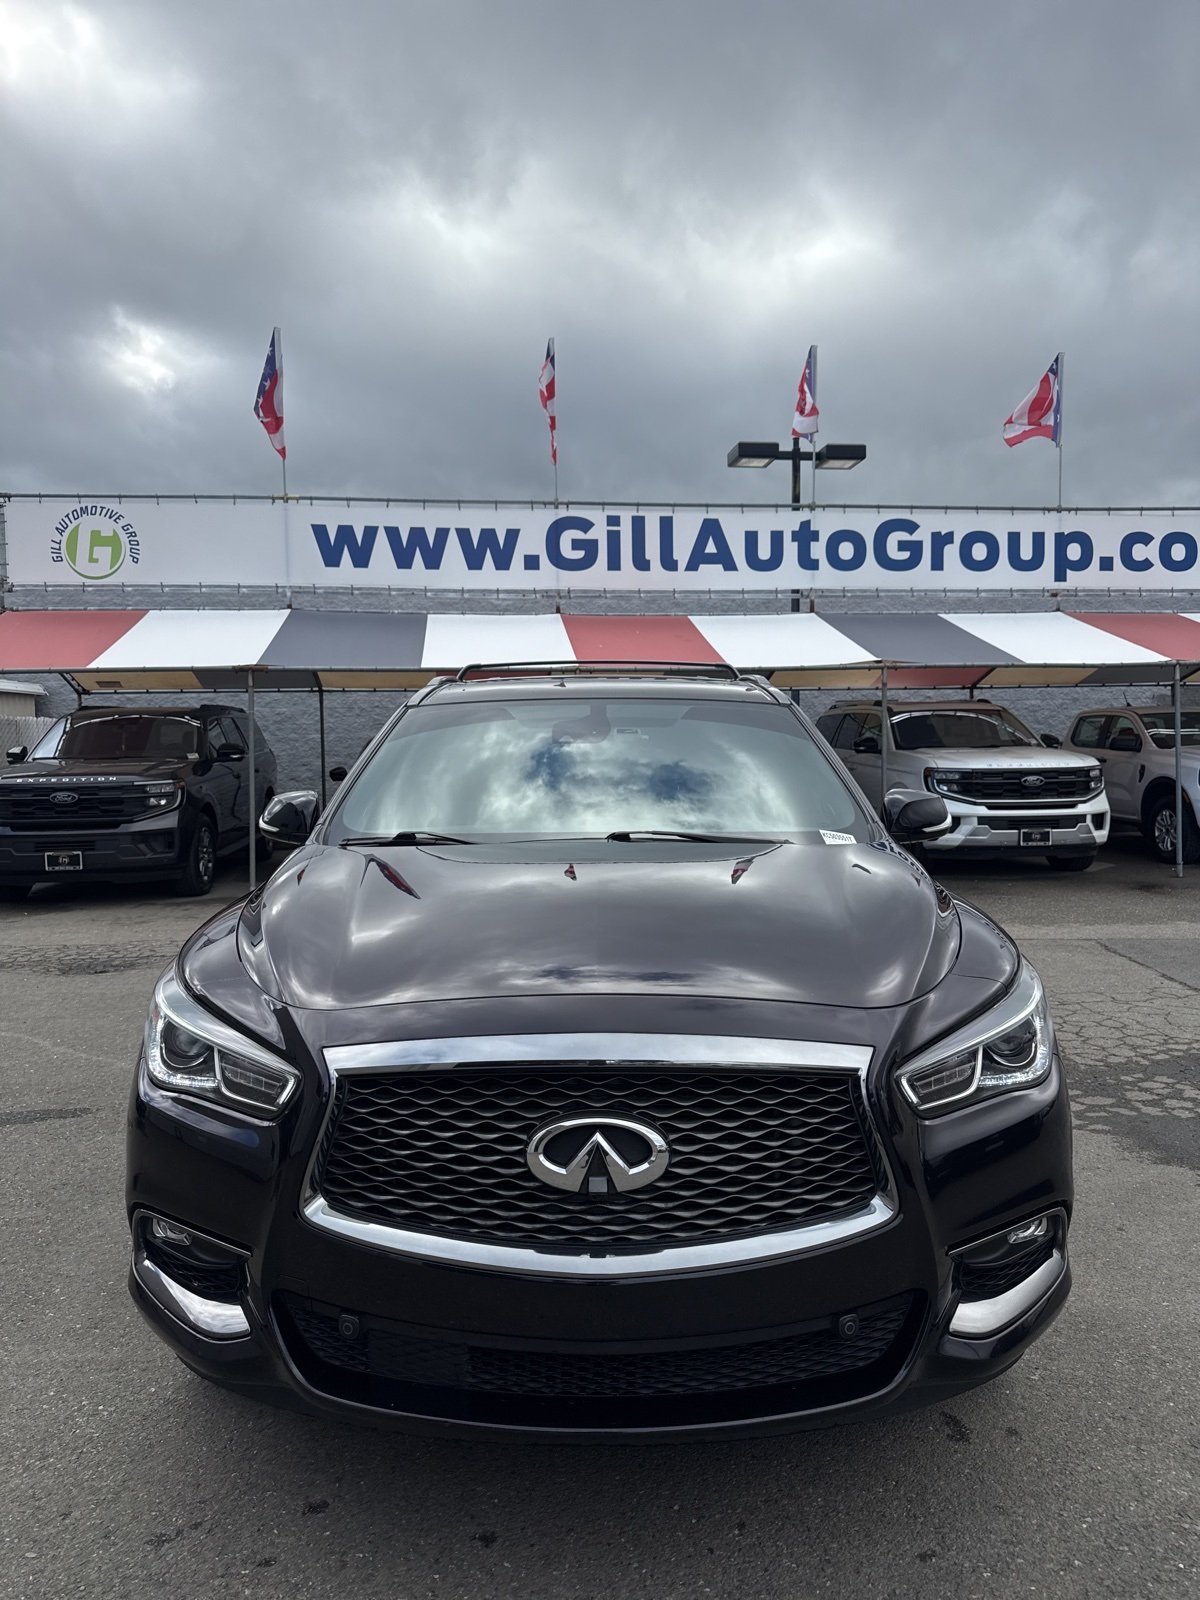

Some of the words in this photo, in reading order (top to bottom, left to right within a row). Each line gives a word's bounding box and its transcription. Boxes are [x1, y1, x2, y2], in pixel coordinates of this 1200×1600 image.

[55, 505, 125, 537] AUTOMOTIVE
[50, 538, 64, 563] GILL
[121, 523, 141, 565] GROUP
